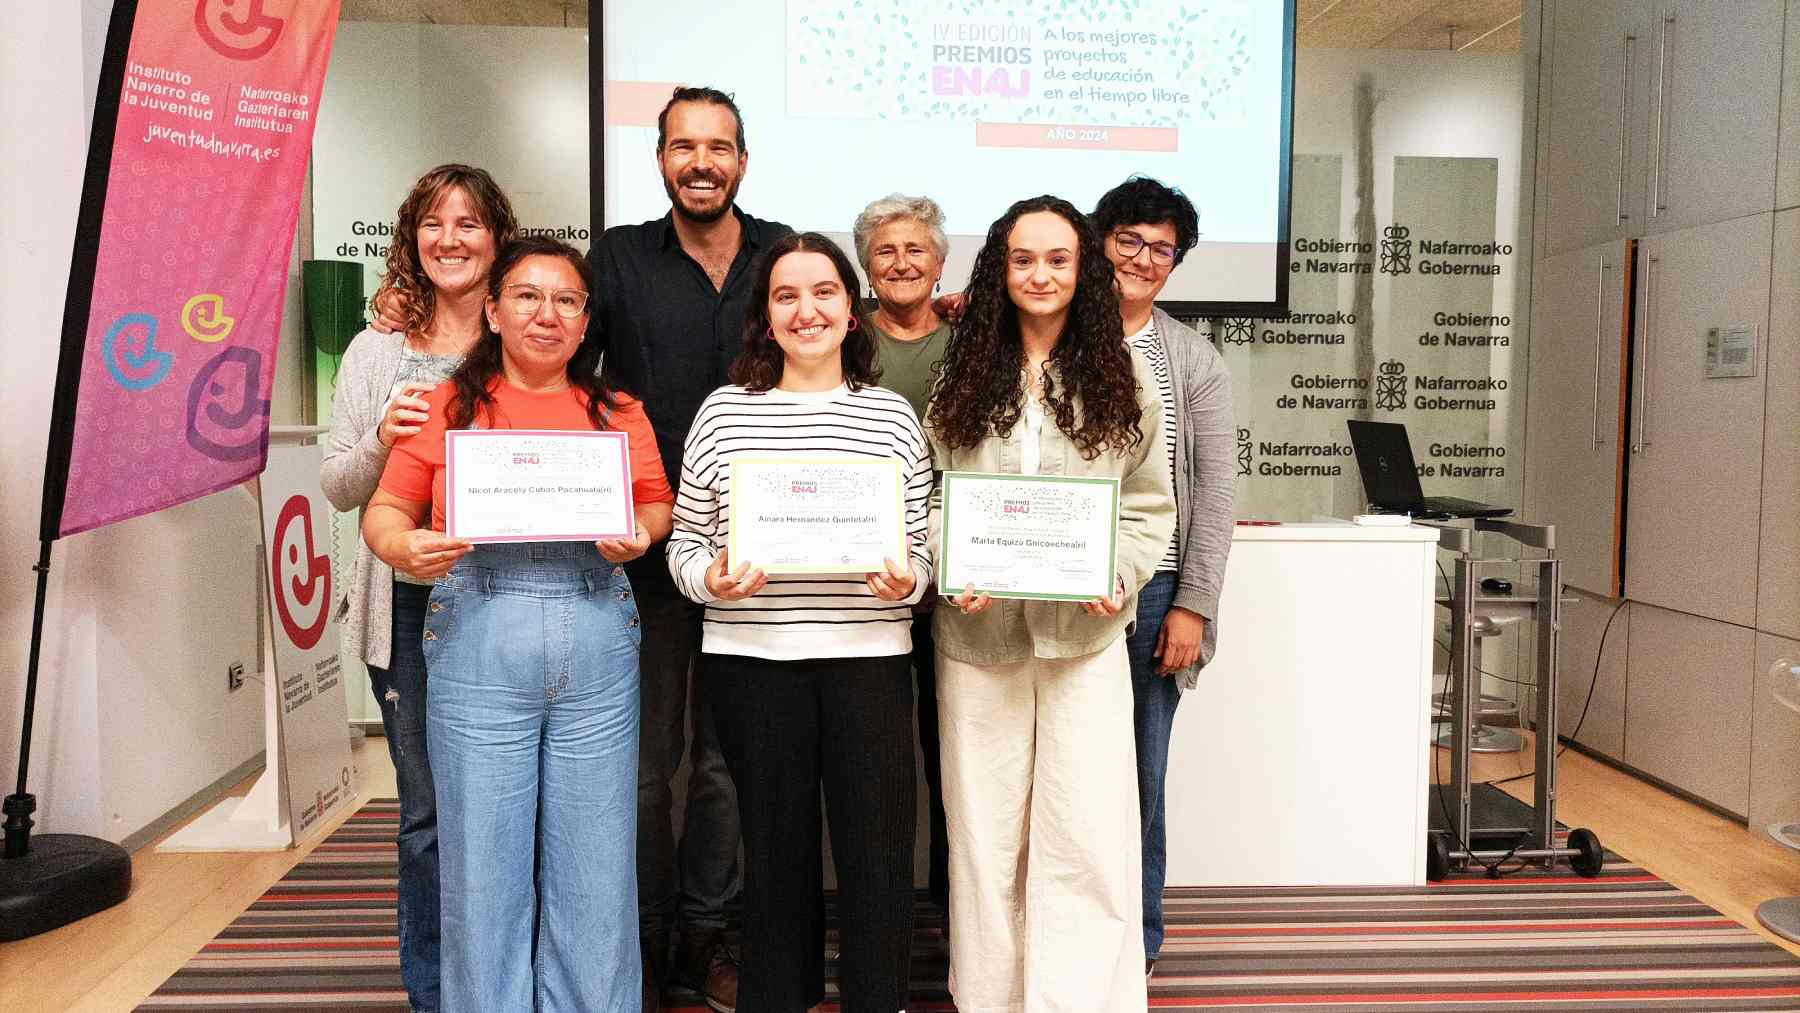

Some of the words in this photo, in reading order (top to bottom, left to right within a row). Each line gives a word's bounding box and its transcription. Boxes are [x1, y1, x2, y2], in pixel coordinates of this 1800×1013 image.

[958, 22, 1032, 43] EDICIÓN
[1044, 28, 1058, 41] A
[1061, 26, 1086, 43] los
[1089, 29, 1158, 47] mejores
[932, 44, 1033, 65] PREMIOS
[1043, 47, 1128, 67] proyectos
[128, 60, 192, 86] Instituto
[1043, 66, 1067, 81] de
[1071, 67, 1154, 83] educación
[126, 76, 187, 100] Navarro
[190, 89, 211, 105] de
[931, 65, 1031, 99] ENAJ
[240, 85, 310, 106] Nafarroako
[1043, 88, 1065, 101] en
[1069, 86, 1085, 101] el
[1087, 86, 1148, 108] tiempo
[1152, 87, 1191, 104] libre
[124, 90, 138, 106] la
[140, 95, 214, 121] Juventud
[237, 99, 310, 121] Gazteriaren
[233, 113, 294, 134] Institutua
[142, 120, 281, 163] juventudnavarra.es
[351, 220, 395, 237] Gobi
[335, 241, 359, 257] de
[1294, 238, 1372, 255] Gobierno
[1418, 239, 1513, 256] Nafarroako
[1305, 259, 1372, 275] Navarra
[1418, 260, 1501, 276] Gobernua
[1433, 311, 1511, 327] Gobierno
[1261, 329, 1346, 346] Gobernua
[1418, 331, 1440, 347] de
[1444, 332, 1510, 347] Navarra
[1290, 374, 1369, 390] Gobierno
[1414, 375, 1508, 392] Nafarroako
[1276, 394, 1298, 410] de
[1302, 395, 1369, 410] Navarra
[1413, 395, 1497, 411] Gobernua
[1258, 441, 1354, 458] Nafarroako
[1429, 443, 1506, 459] Gobierno
[1258, 462, 1342, 478] Gobernua
[1416, 464, 1436, 479] de
[1440, 464, 1506, 479] Navarra
